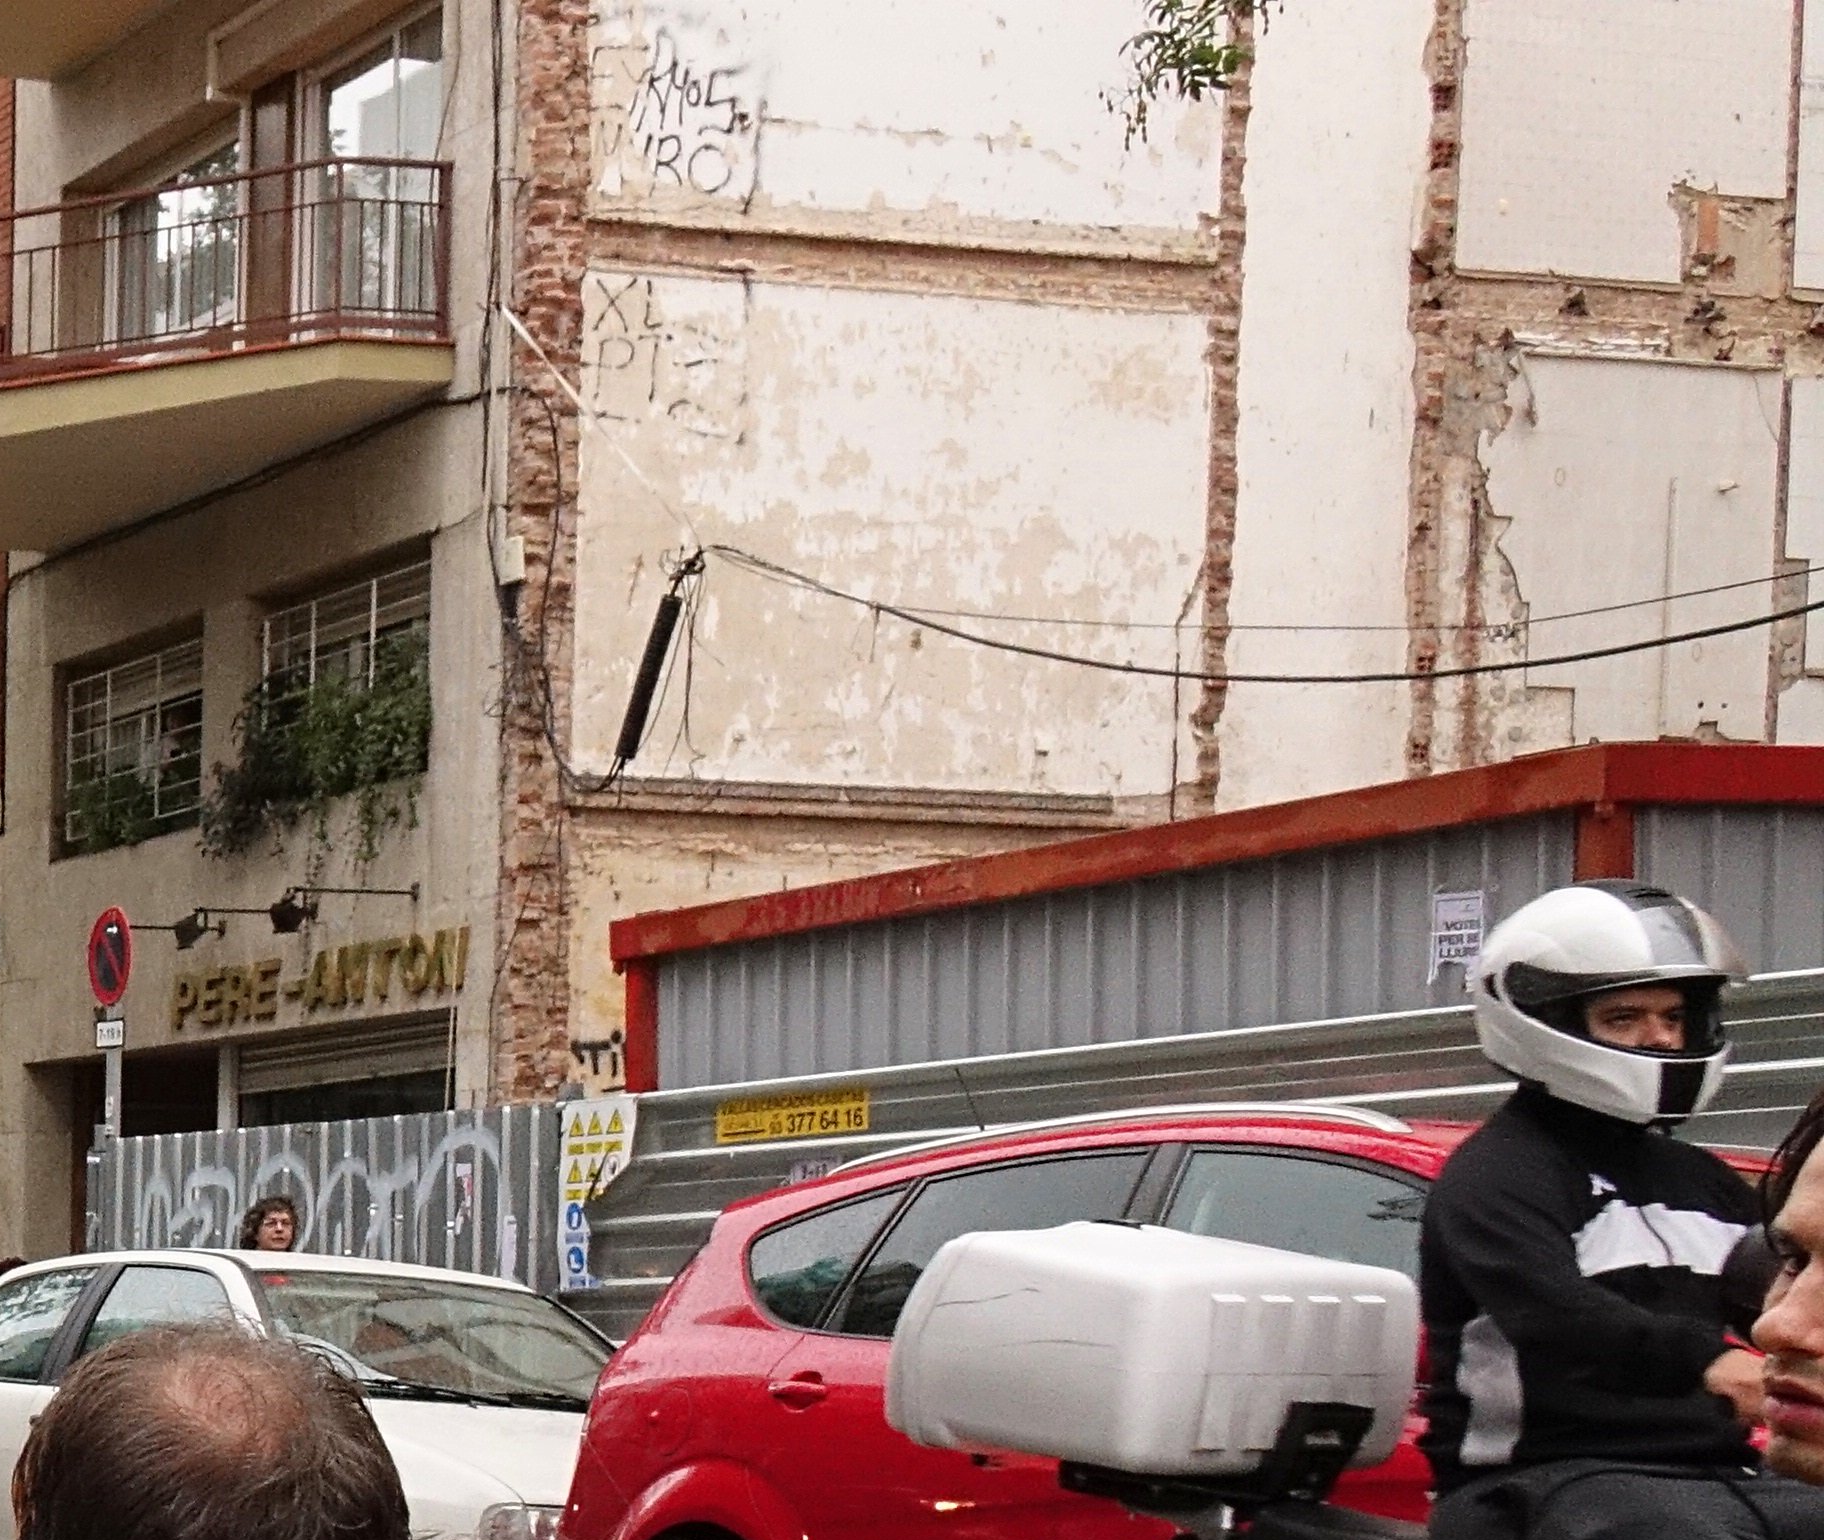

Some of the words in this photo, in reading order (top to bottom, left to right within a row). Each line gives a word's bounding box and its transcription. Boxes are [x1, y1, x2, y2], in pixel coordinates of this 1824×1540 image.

[785, 1111, 817, 1134] 377
[819, 1109, 839, 1131] 64
[844, 1106, 864, 1128] 16
